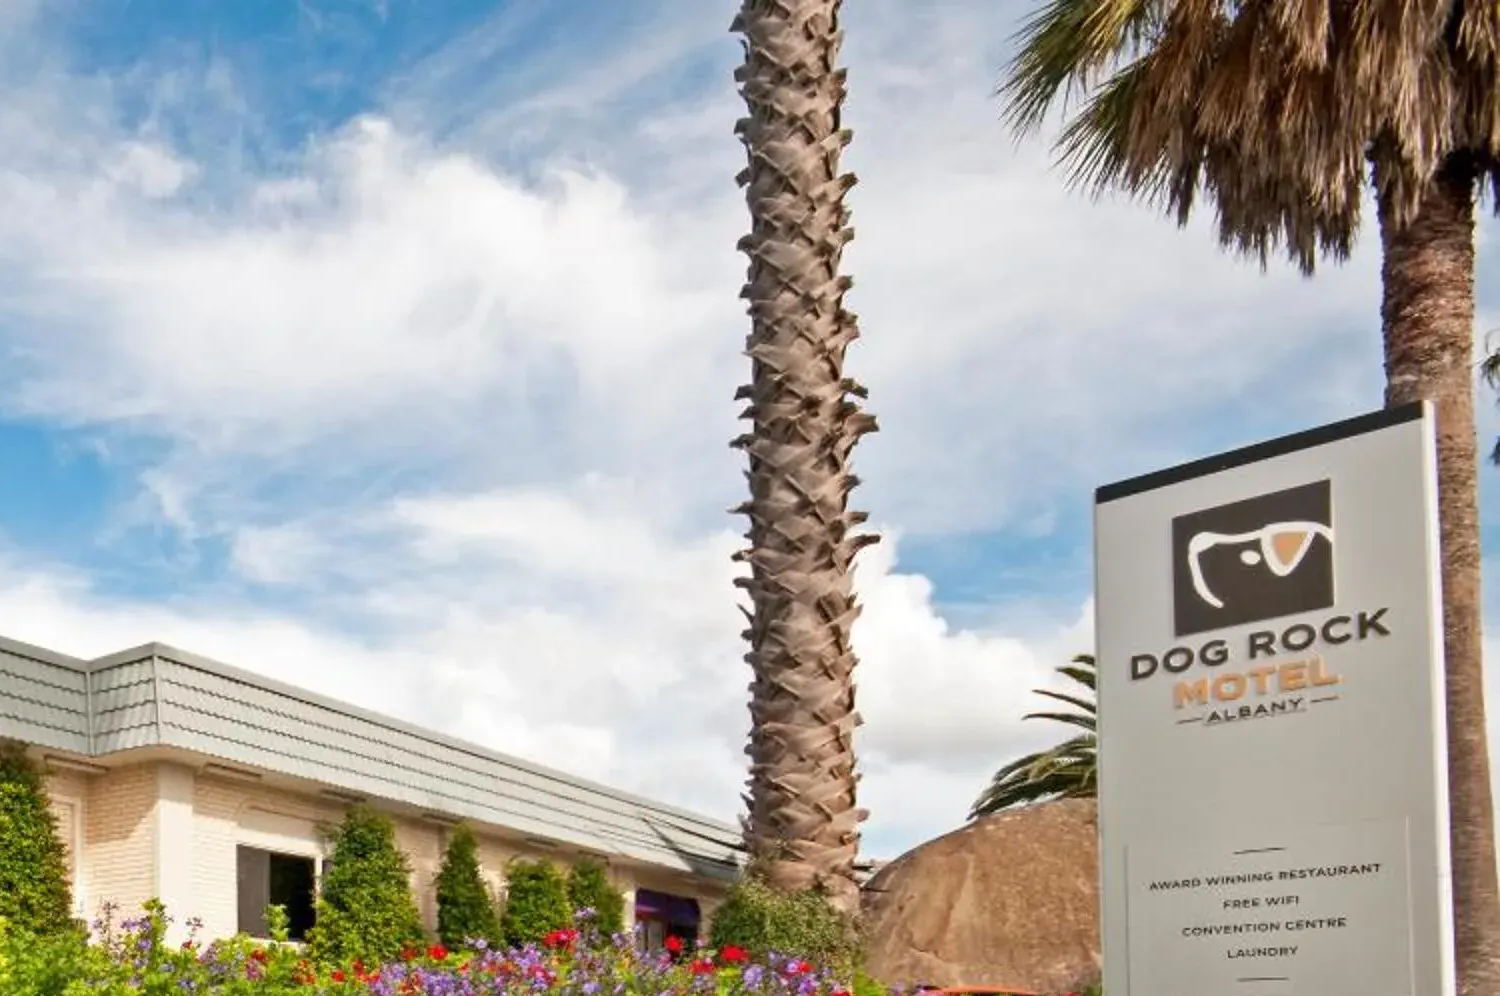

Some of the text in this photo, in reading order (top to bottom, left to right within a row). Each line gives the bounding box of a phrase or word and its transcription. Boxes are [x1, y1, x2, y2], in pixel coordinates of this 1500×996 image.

[1131, 608, 1391, 681] DOG ROCK
[1173, 656, 1341, 709] MOTEL
[1206, 698, 1304, 723] ALBANY
[1149, 863, 1381, 891] AWARD WINNING RESTAURANT
[1223, 895, 1300, 910] FREE WIFI
[1182, 917, 1348, 937] CONVENTION CENTRE
[1227, 946, 1299, 959] LAUNDRY
